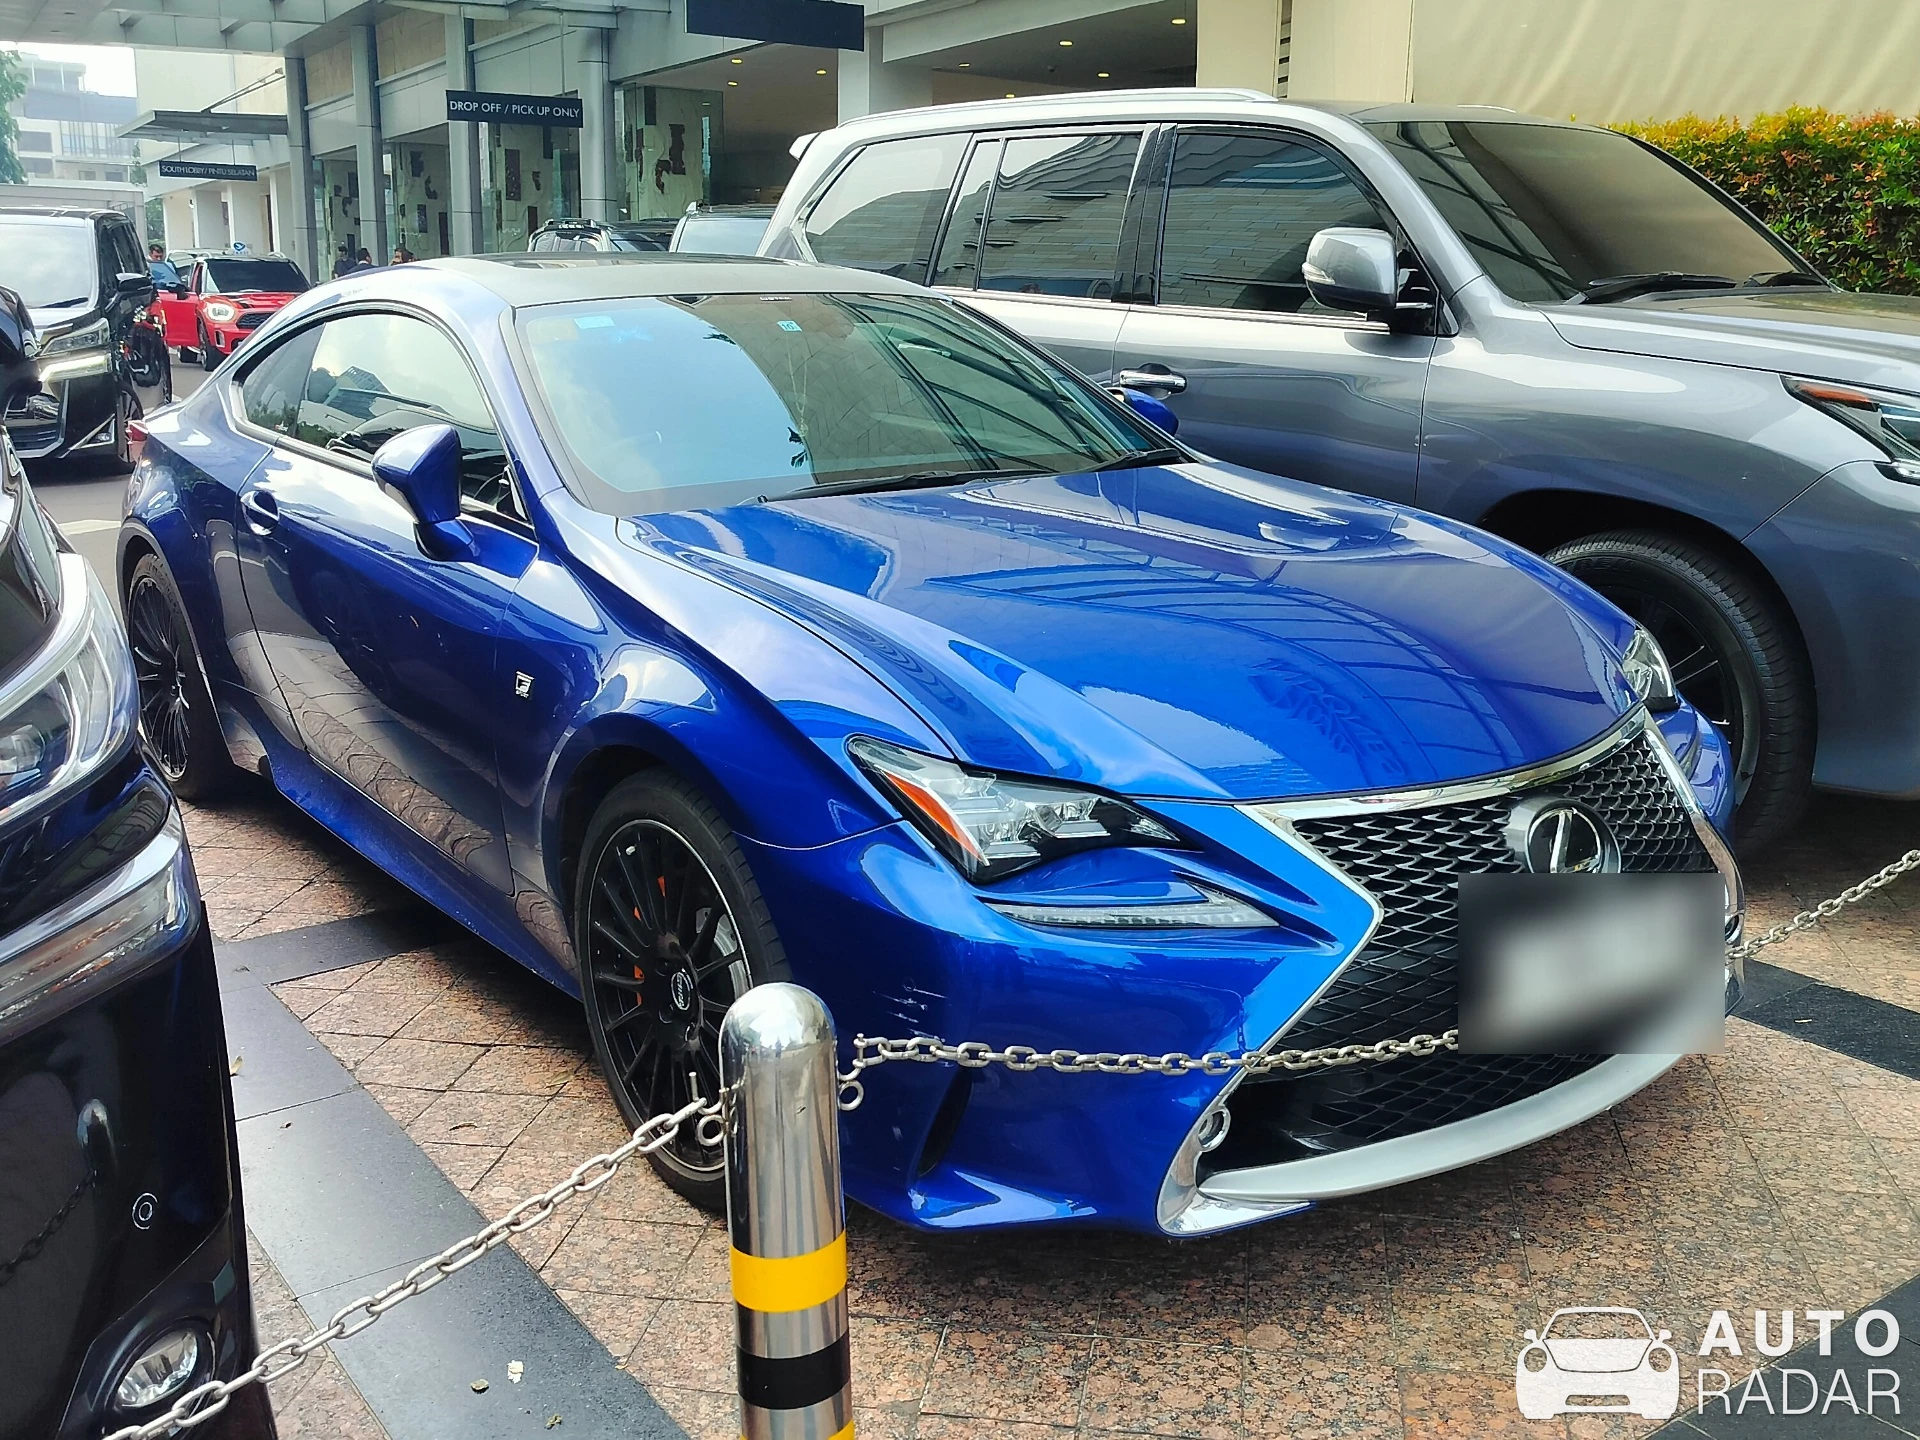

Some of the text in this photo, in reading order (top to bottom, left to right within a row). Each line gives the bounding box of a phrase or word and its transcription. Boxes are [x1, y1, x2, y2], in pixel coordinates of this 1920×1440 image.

[450, 101, 478, 112] DROP
[481, 102, 501, 113] OFF
[512, 104, 534, 115] PICK
[537, 105, 550, 116] UP
[553, 107, 580, 118] ONLY
[161, 165, 185, 173] SOUTH
